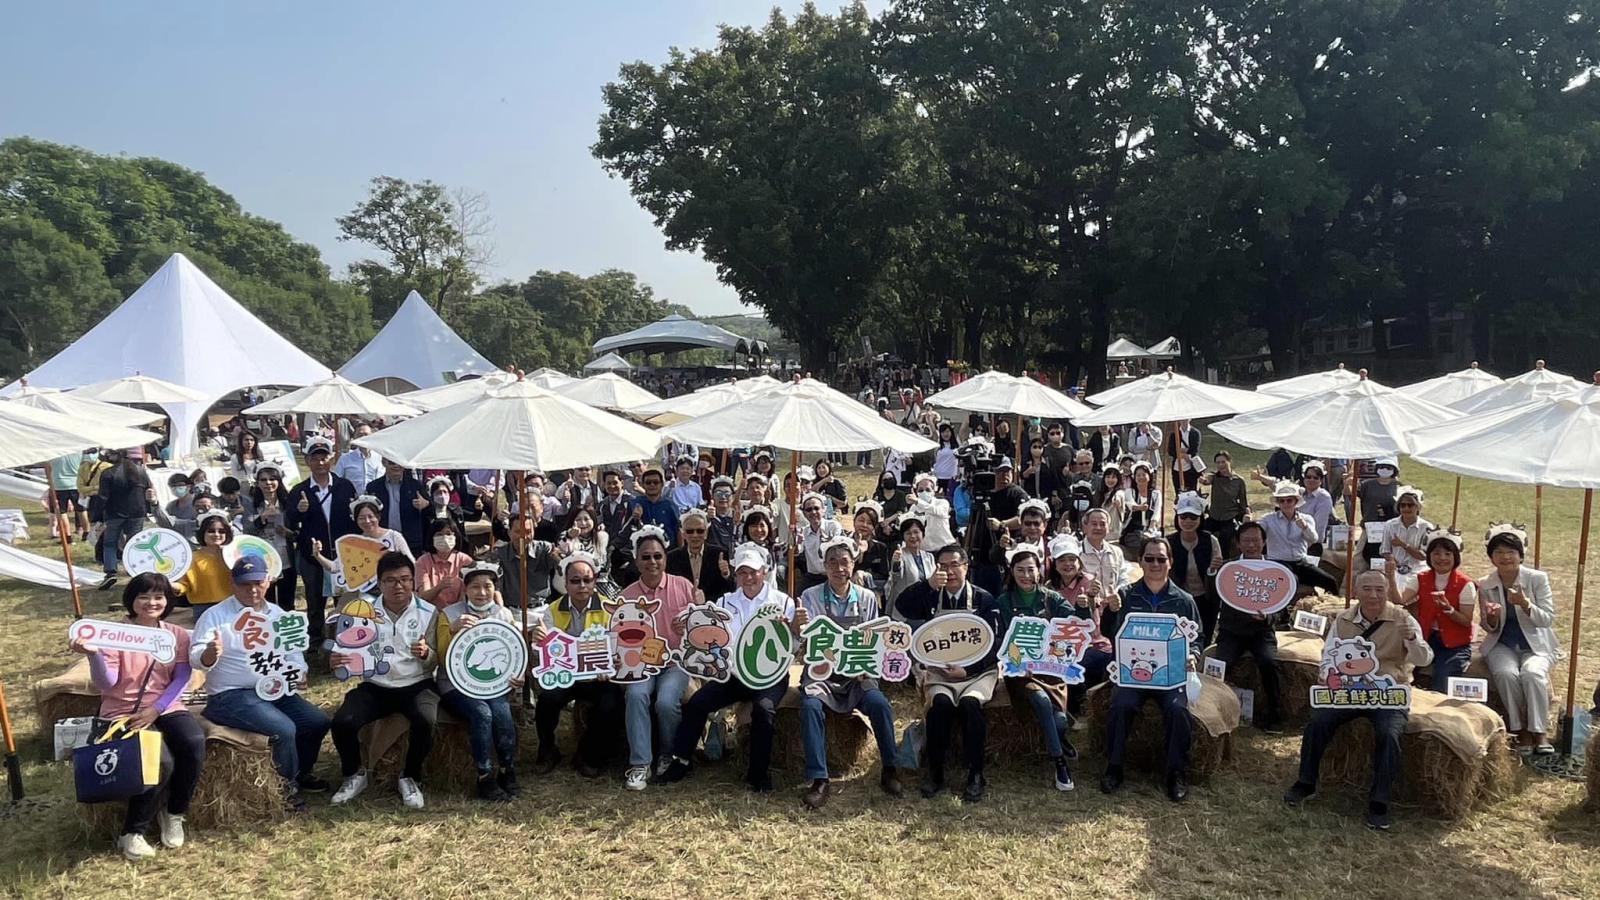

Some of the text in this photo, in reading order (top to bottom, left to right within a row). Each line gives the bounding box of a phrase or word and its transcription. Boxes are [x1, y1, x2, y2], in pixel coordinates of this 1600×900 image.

[99, 629, 145, 644] Follow
[234, 611, 305, 651] 食農
[802, 618, 880, 676] 食農
[923, 628, 982, 653] 日日好農
[1002, 621, 1091, 660] 農畜
[1132, 625, 1161, 637] MILK
[536, 630, 610, 673] 食農
[889, 629, 907, 674] 教育
[249, 651, 301, 693] 教育
